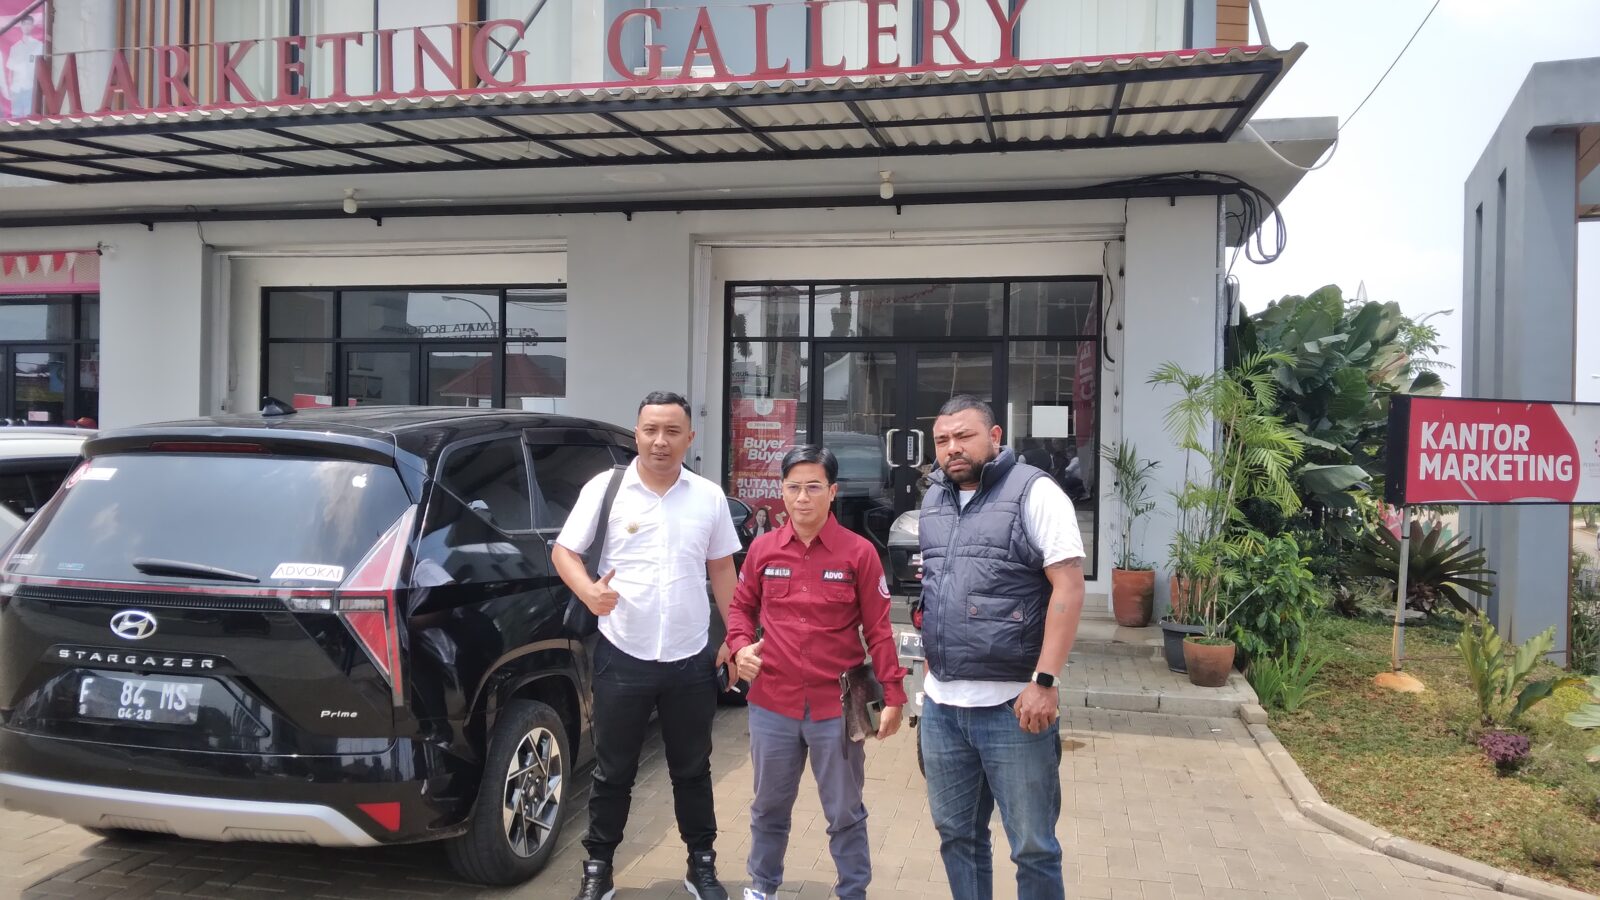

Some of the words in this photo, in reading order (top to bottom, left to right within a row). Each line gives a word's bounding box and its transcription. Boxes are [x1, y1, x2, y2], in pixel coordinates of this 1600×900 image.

[28, 19, 528, 118] MARKETING
[607, 0, 1026, 82] GALLERY
[743, 437, 786, 452] Buyer
[1420, 421, 1531, 451] KANTOR
[1419, 452, 1573, 481] MARKETING
[58, 649, 214, 668] STARGAZER
[79, 677, 94, 703] F
[120, 680, 147, 707] 84
[159, 683, 189, 711] MS
[320, 710, 358, 718] Prime
